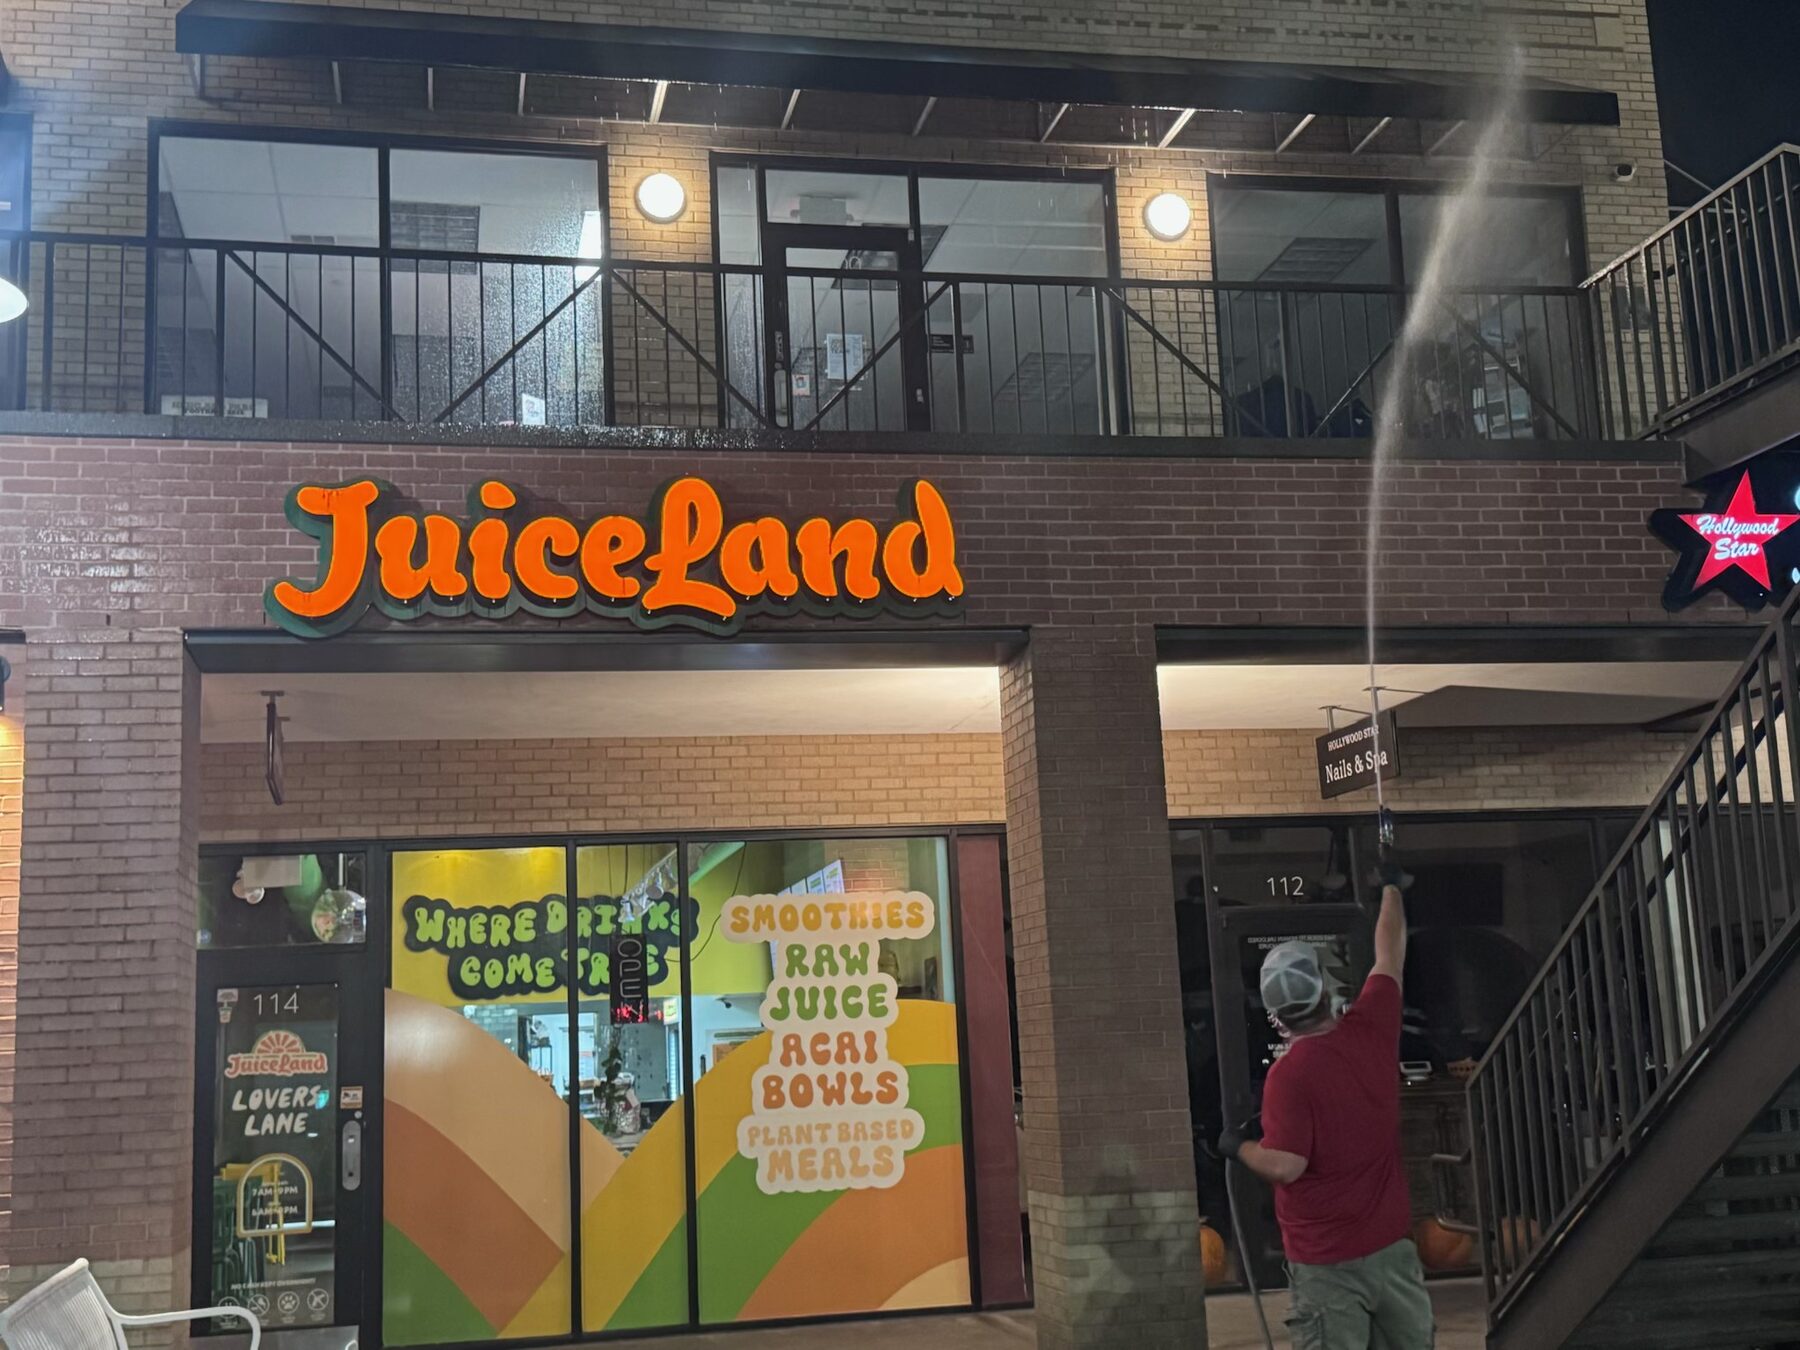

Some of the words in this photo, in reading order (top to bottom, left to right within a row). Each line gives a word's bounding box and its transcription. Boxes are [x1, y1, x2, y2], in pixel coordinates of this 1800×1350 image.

[1697, 515, 1779, 539] Hollywood
[274, 477, 964, 619] JuiceLand
[1714, 537, 1760, 560] Star
[1327, 729, 1363, 752] HOLLYWOOD
[1363, 724, 1380, 739] STAR
[1325, 758, 1353, 784] Nails
[1354, 754, 1364, 774] &
[1365, 750, 1389, 774] Spa
[1266, 876, 1304, 897] 112
[415, 907, 537, 948] WHERE
[730, 901, 926, 934] SMOOTHIES
[460, 953, 556, 989] COME
[561, 944, 661, 987] TRE
[784, 942, 871, 978] RAW
[253, 992, 300, 1016] 114
[769, 983, 889, 1021] JUICE
[225, 1052, 327, 1077] JuiceLand
[779, 1030, 879, 1068] ACAI
[231, 1085, 322, 1112] LOVERS
[762, 1071, 899, 1110] BOWLS
[244, 1112, 309, 1137] LANE
[747, 1122, 832, 1148] PLANT
[837, 1118, 915, 1143] BASED
[766, 1144, 895, 1184] MEALS
